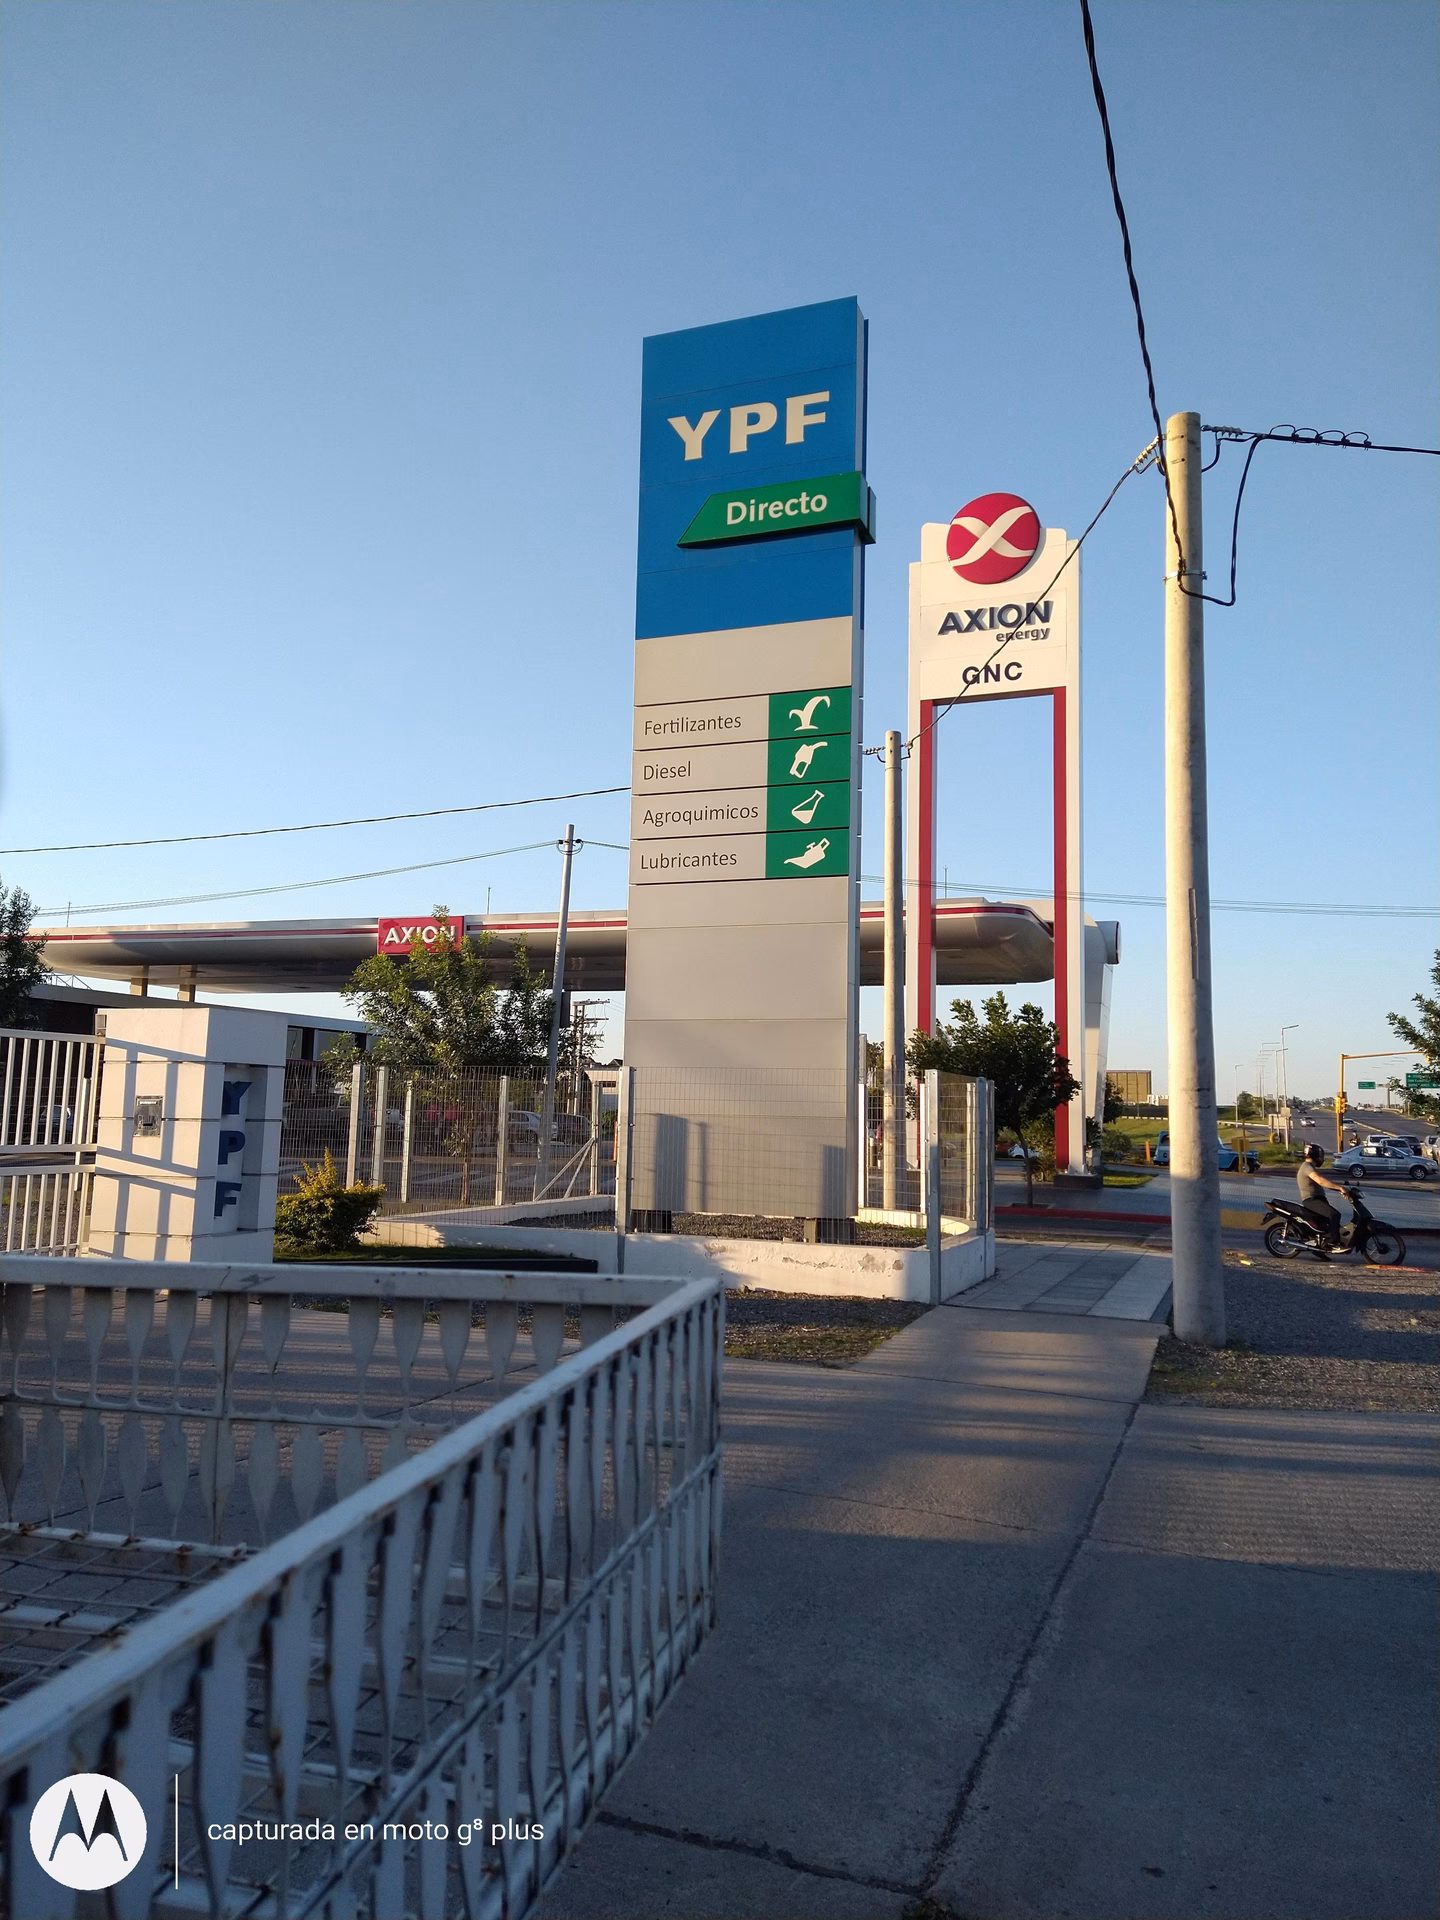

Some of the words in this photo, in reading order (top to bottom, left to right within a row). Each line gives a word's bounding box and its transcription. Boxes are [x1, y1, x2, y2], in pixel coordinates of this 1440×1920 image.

[667, 391, 830, 461] YPF
[726, 491, 828, 525] Directo
[938, 600, 1053, 635] AXION
[995, 627, 1050, 642] energy
[962, 661, 1023, 684] GNC
[644, 715, 742, 736] Fertilizantes
[643, 760, 692, 780] Diesel
[642, 804, 759, 827] Agroquimicos
[641, 851, 738, 870] Lubricantes
[213, 1080, 253, 1217] YPF
